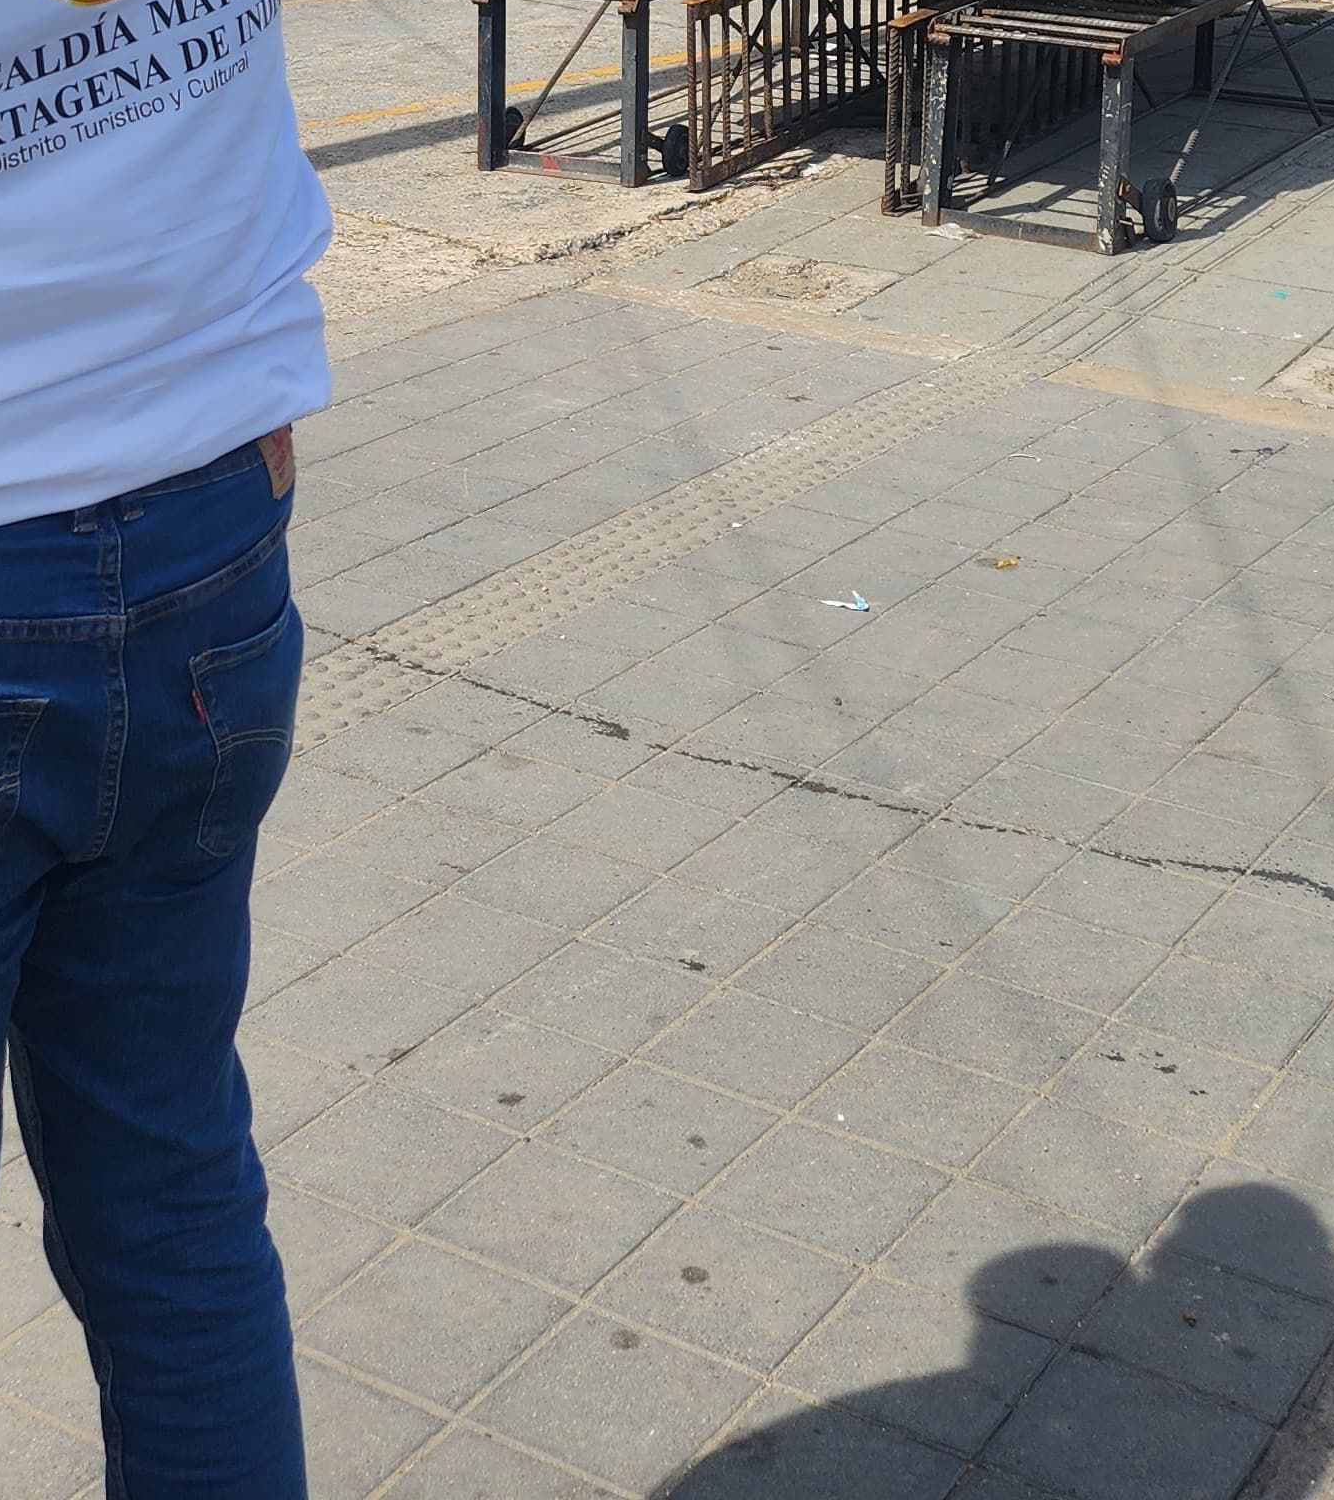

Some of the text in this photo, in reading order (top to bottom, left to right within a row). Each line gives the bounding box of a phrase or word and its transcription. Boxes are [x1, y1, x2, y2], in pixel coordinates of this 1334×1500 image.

[179, 25, 231, 74] DE
[168, 89, 182, 111] y
[187, 51, 250, 100] Cultural
